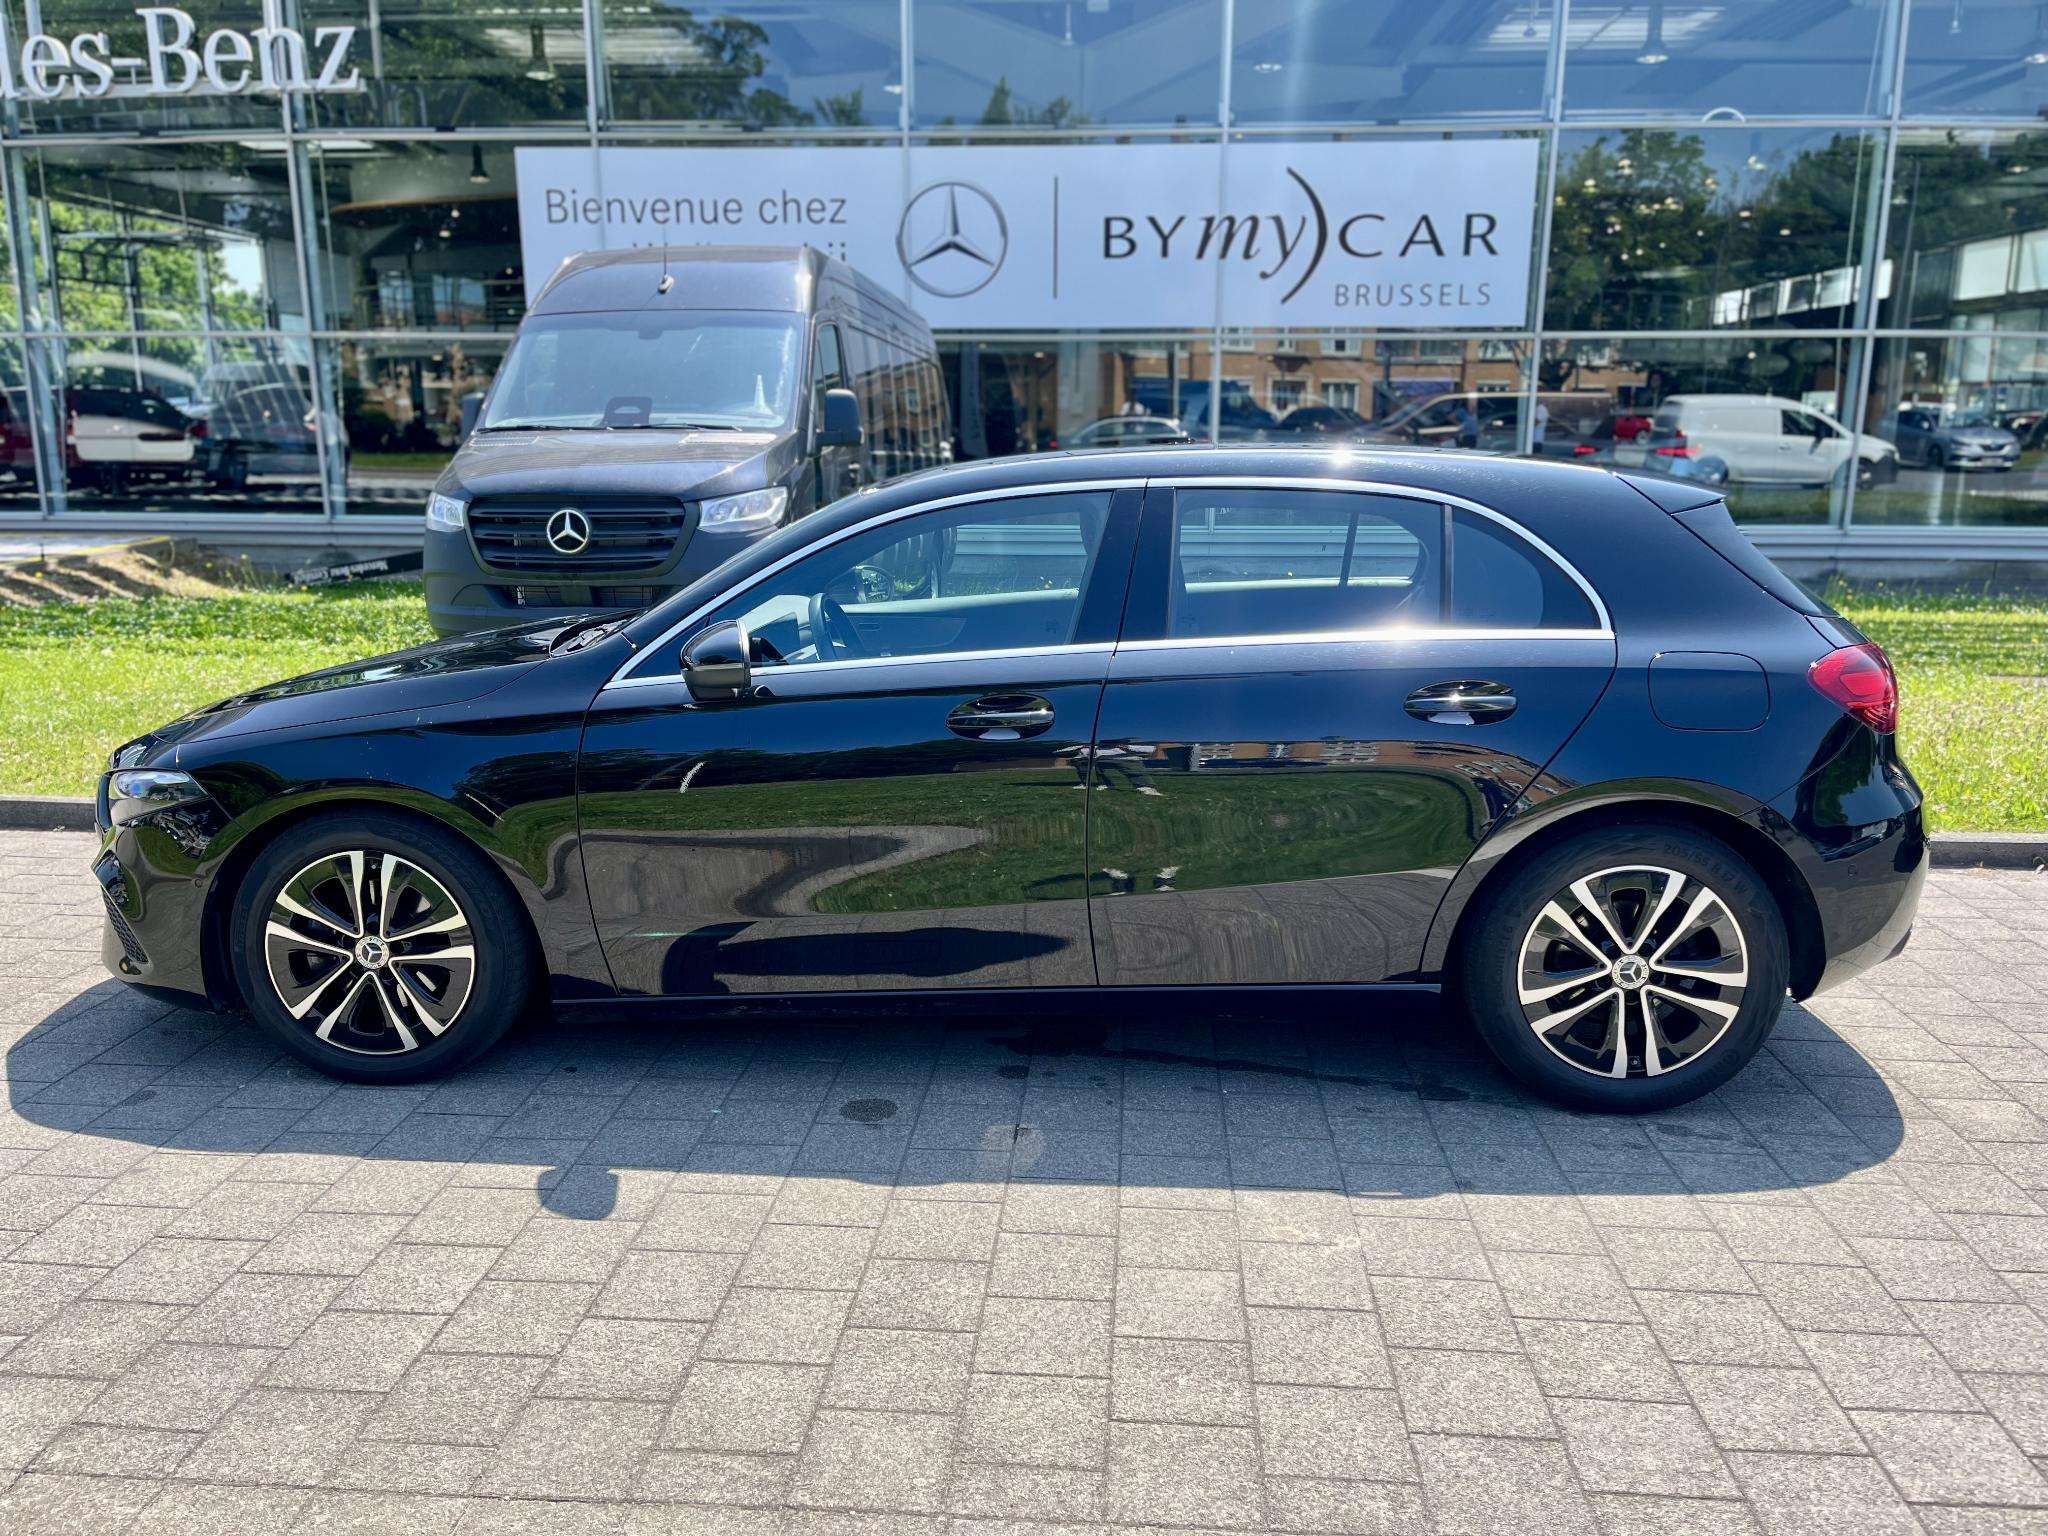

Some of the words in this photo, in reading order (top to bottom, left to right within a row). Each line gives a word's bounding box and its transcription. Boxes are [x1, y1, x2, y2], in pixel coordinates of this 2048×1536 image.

[546, 189, 742, 224] Bienvenue
[759, 190, 847, 224] chez
[1335, 283, 1491, 307] BRUSSELS
